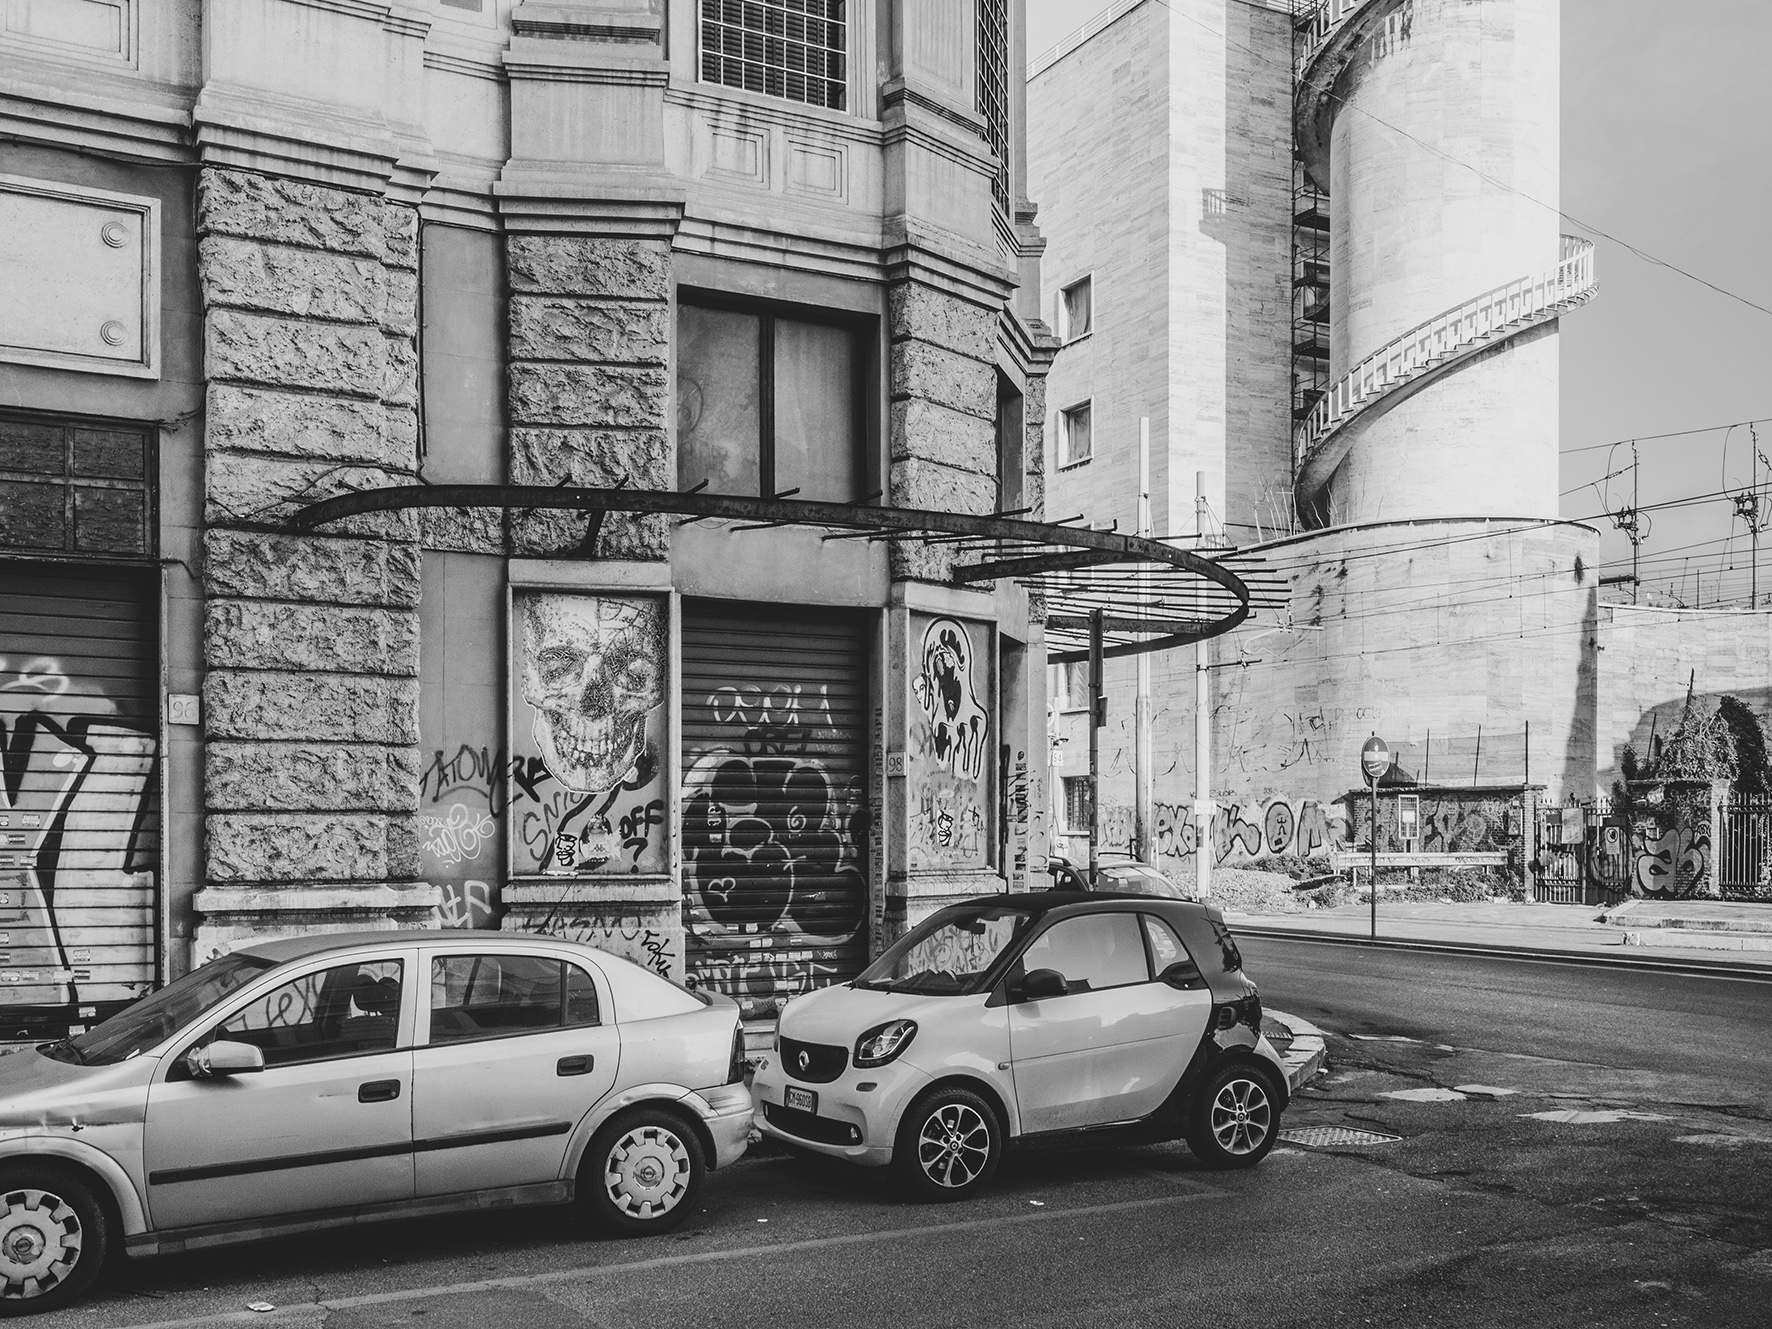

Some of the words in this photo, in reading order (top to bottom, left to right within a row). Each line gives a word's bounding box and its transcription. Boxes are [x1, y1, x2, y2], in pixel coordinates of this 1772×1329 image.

[172, 701, 196, 719] 96
[889, 757, 903, 772] 98
[620, 799, 664, 839] OFF
